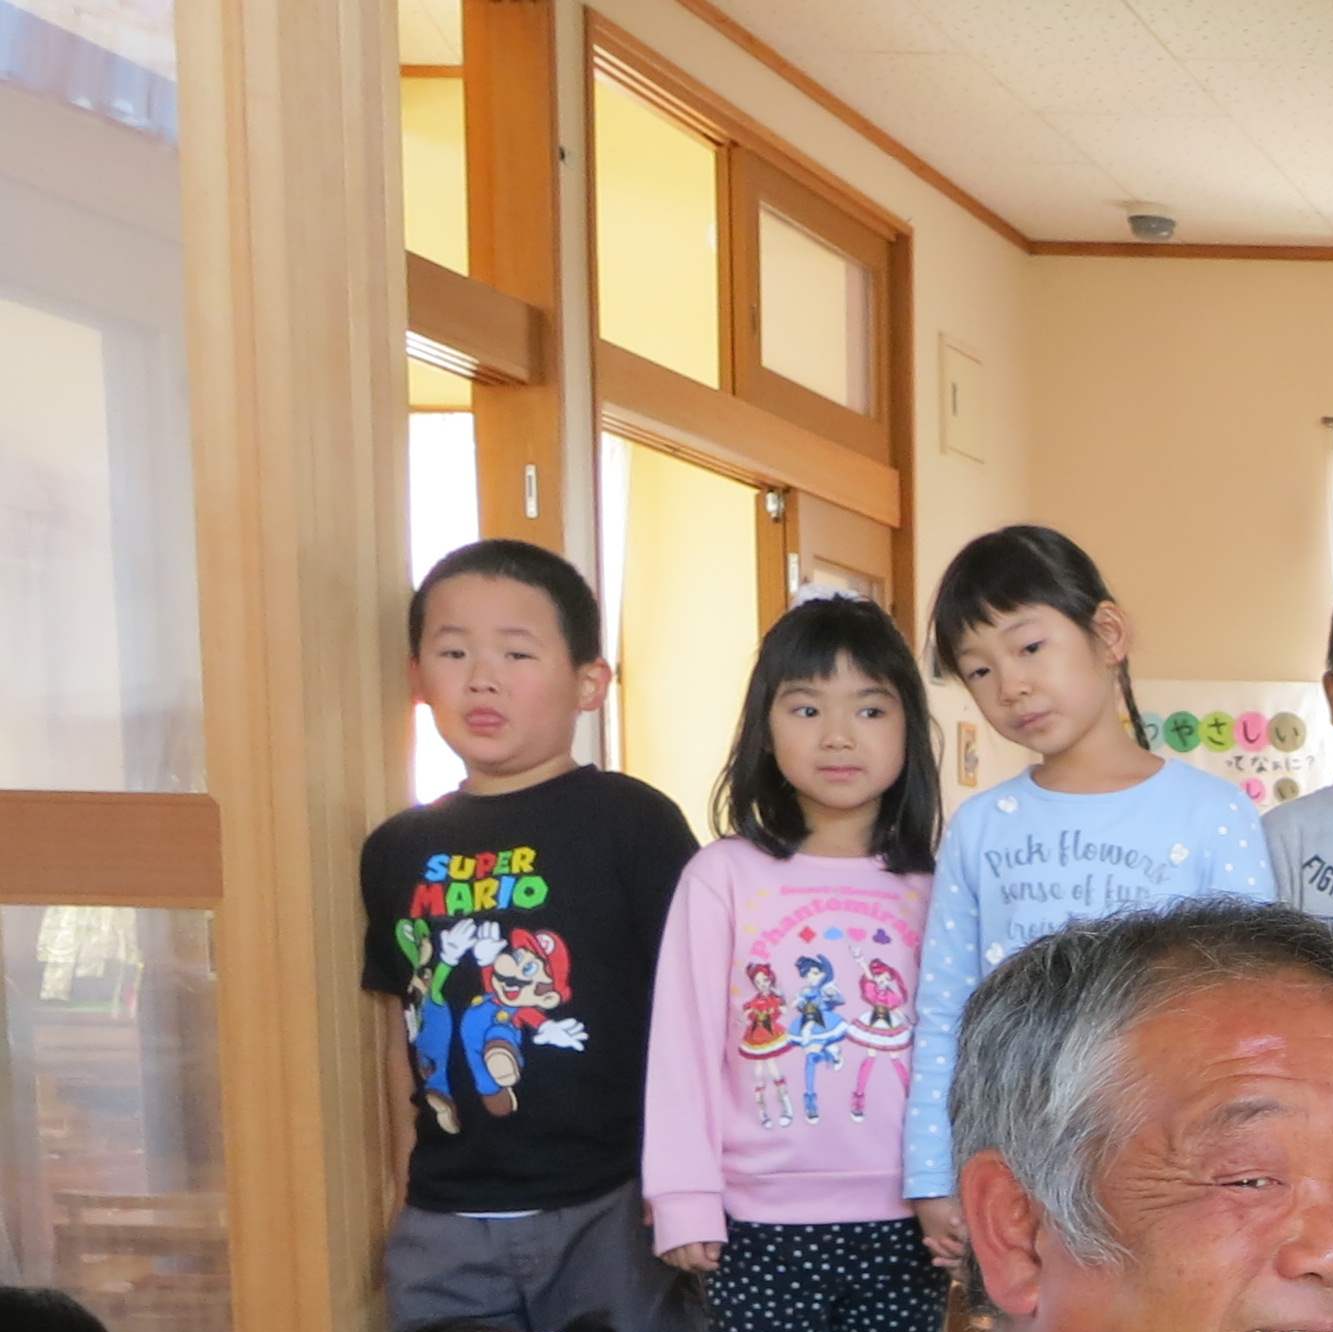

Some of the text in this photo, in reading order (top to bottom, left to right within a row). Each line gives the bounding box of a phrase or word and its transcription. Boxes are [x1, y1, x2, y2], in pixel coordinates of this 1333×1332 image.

[424, 846, 537, 882] SUPER
[984, 829, 1170, 884] pick flowers
[410, 875, 549, 919] MARIO
[1071, 873, 1096, 906] of
